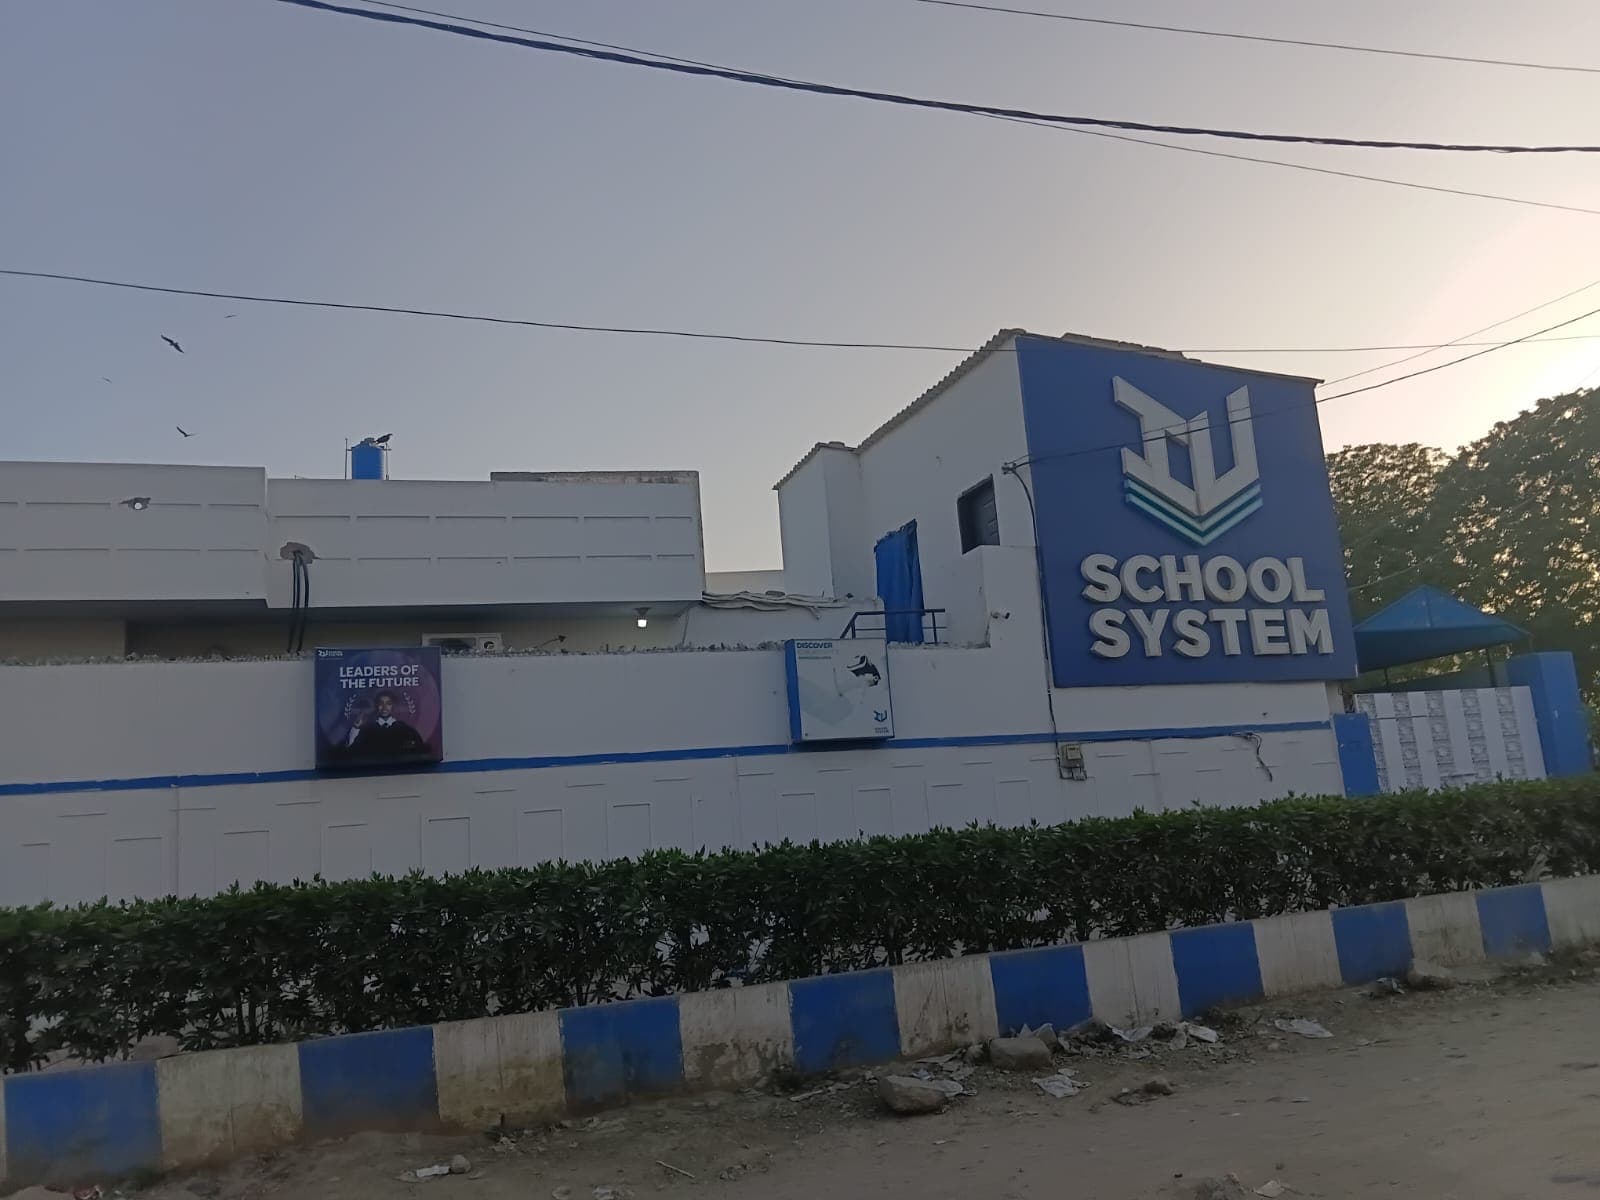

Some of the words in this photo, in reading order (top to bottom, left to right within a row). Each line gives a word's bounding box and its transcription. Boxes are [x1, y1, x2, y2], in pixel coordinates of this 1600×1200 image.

[1080, 553, 1326, 604] SCHOOL
[1088, 608, 1335, 658] SYSTEM
[339, 665, 398, 678] LEADERS
[400, 664, 419, 675] OF
[340, 678, 367, 689] THE
[368, 677, 420, 688] FUTURE
